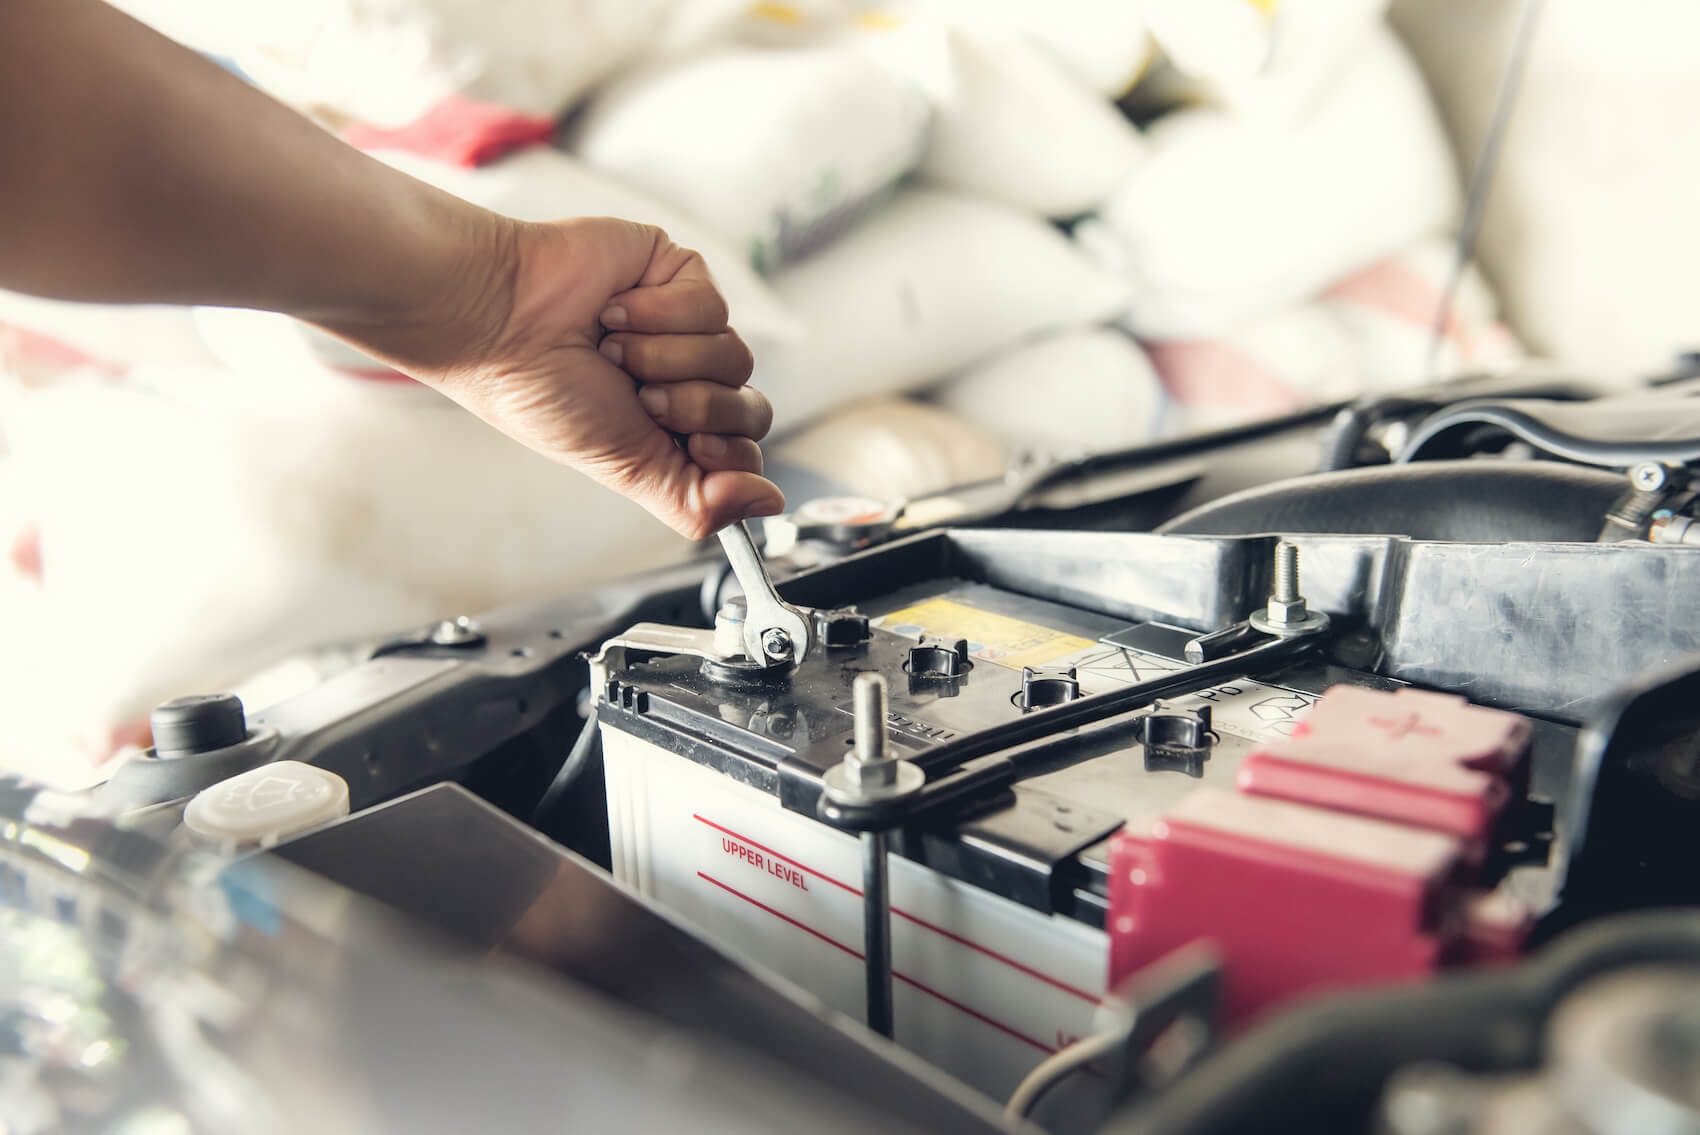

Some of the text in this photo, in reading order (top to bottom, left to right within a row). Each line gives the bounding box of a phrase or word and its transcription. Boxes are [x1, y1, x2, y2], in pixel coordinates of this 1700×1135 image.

[1193, 686, 1243, 702] Pb
[722, 837, 809, 892] UPPER LEVEL
